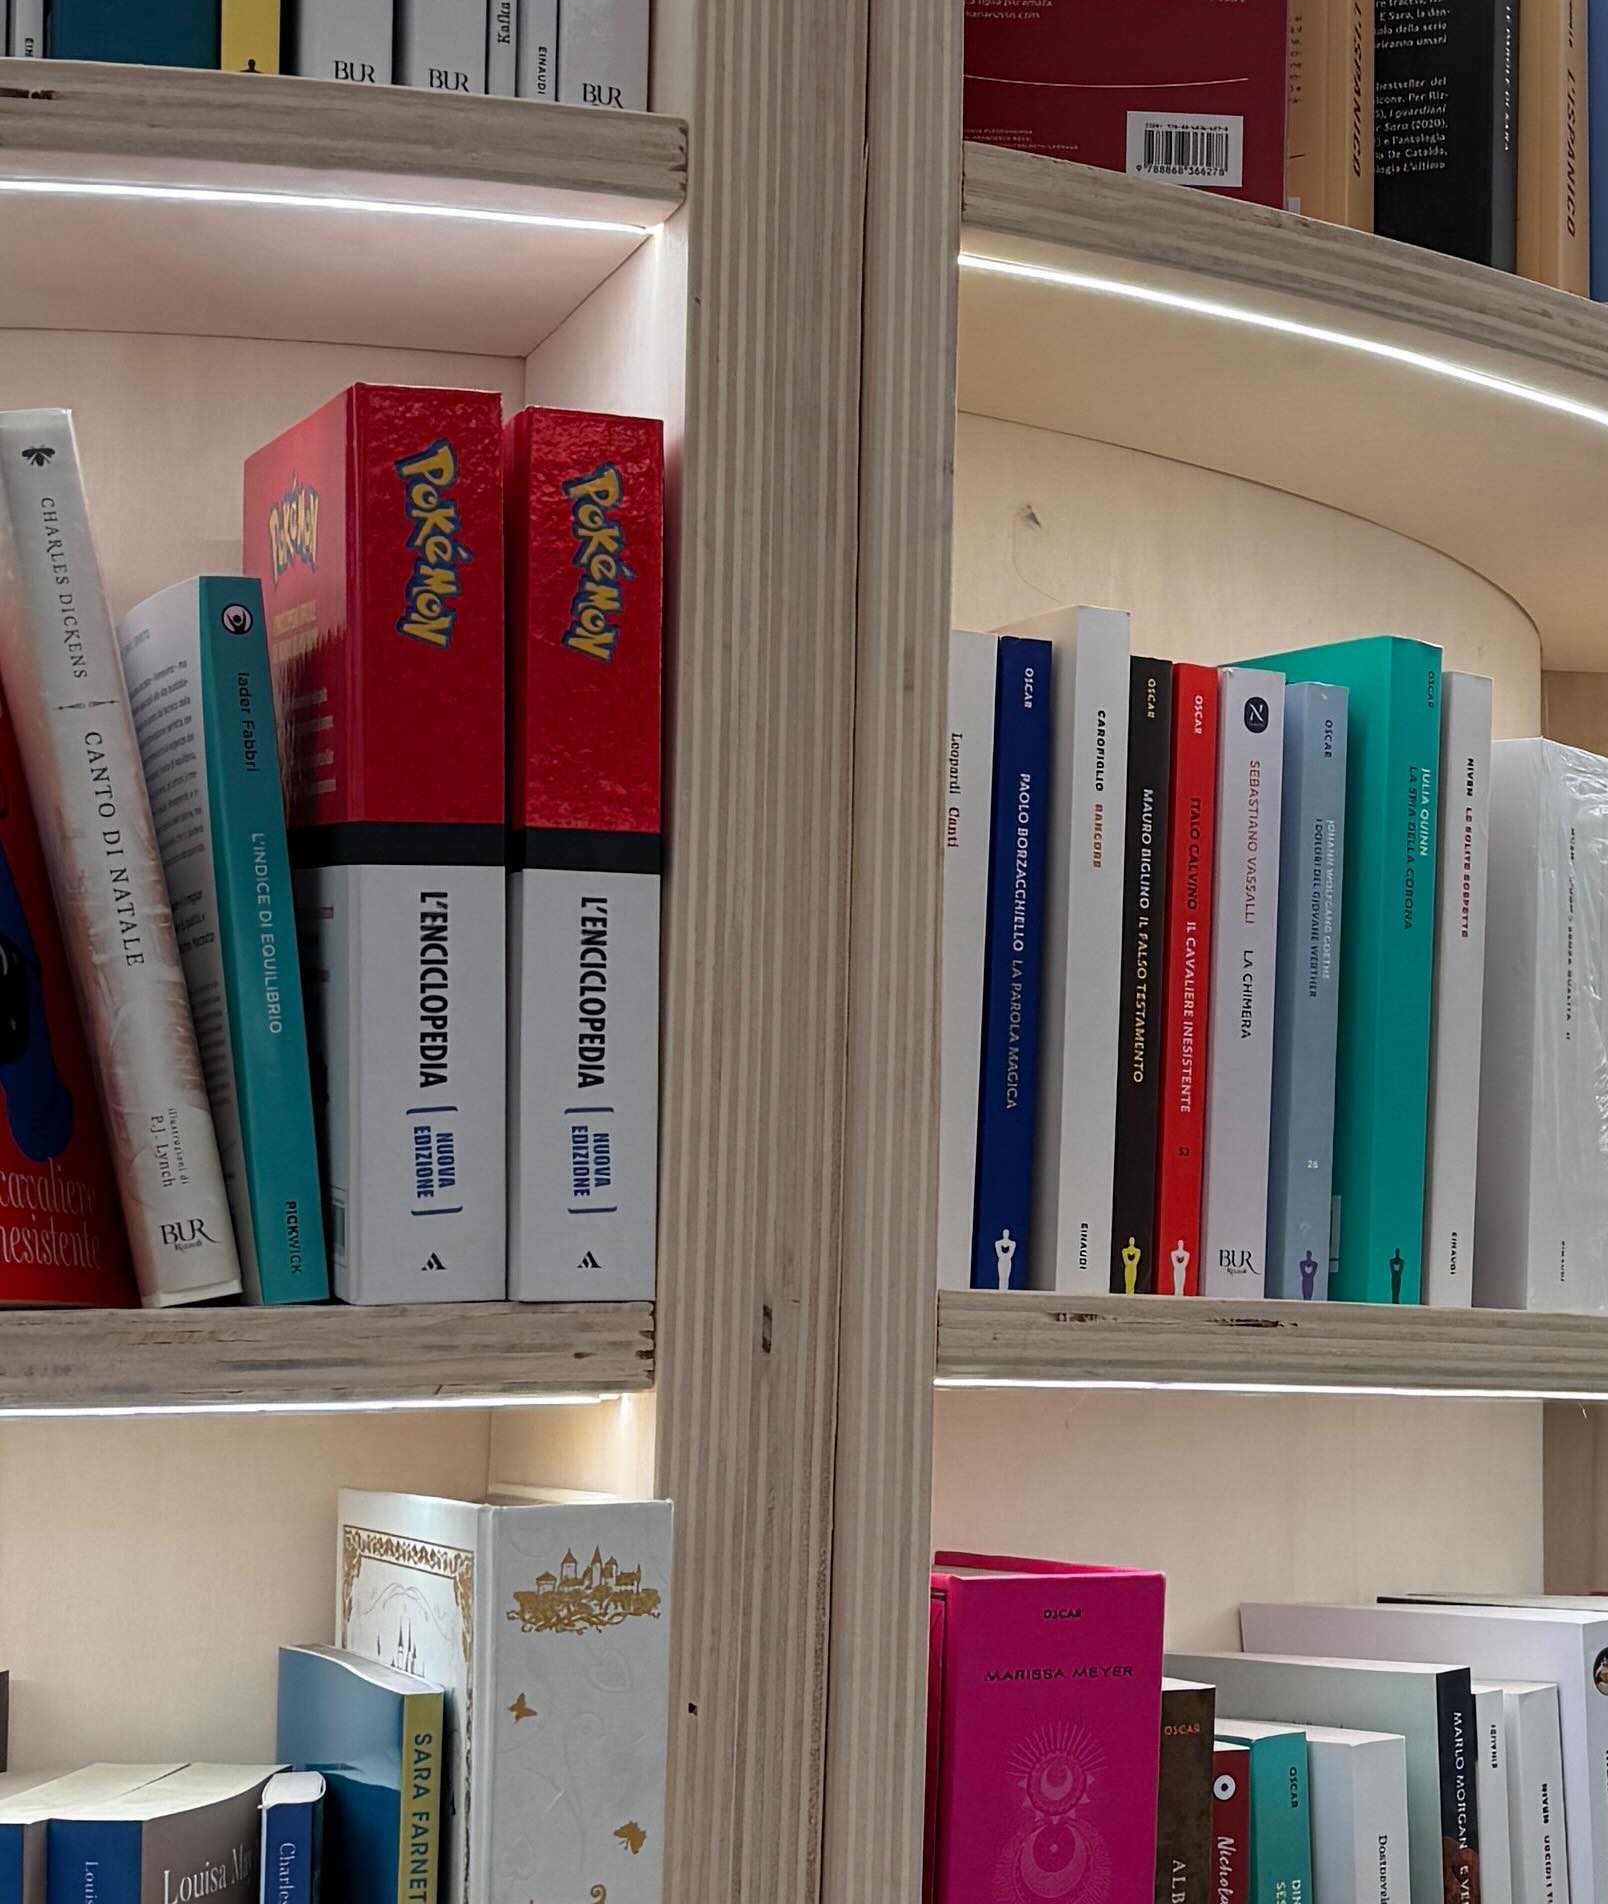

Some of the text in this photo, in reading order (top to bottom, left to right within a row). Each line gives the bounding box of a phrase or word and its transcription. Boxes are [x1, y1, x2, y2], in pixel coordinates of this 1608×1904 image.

[334, 60, 376, 84] BUR
[41, 497, 87, 678] CHARLES DICKENS
[85, 732, 144, 966] CANTO DI NATALE
[1013, 773, 1030, 951] PAOLO BORZACCHIELLO
[1140, 789, 1153, 909] MAURO BIGLINO
[1245, 760, 1260, 924] SEBASTIANO VASSALLI
[252, 833, 282, 1033] L'INDICE DI EQUILIBRIO
[420, 892, 448, 1088] L'ENCICLOPEDIA
[578, 897, 607, 1088] L'ENCICLOPEDIA
[1133, 917, 1149, 1083] IL FALSO TESTAMENTO
[1241, 950, 1253, 1038] LA CHIMERA
[1006, 960, 1023, 1109] LA PAROLA MAGICA
[1181, 922, 1196, 1112] IL CAVALIERE INESISTENTE
[160, 1218, 221, 1245] BUR
[414, 1126, 434, 1198] EDIZIONE
[437, 1133, 455, 1189] NUOVA
[286, 1201, 301, 1273] PICKWICK
[984, 1666, 1132, 1681] MARISSA MEYER
[412, 1734, 432, 1800] SARA
